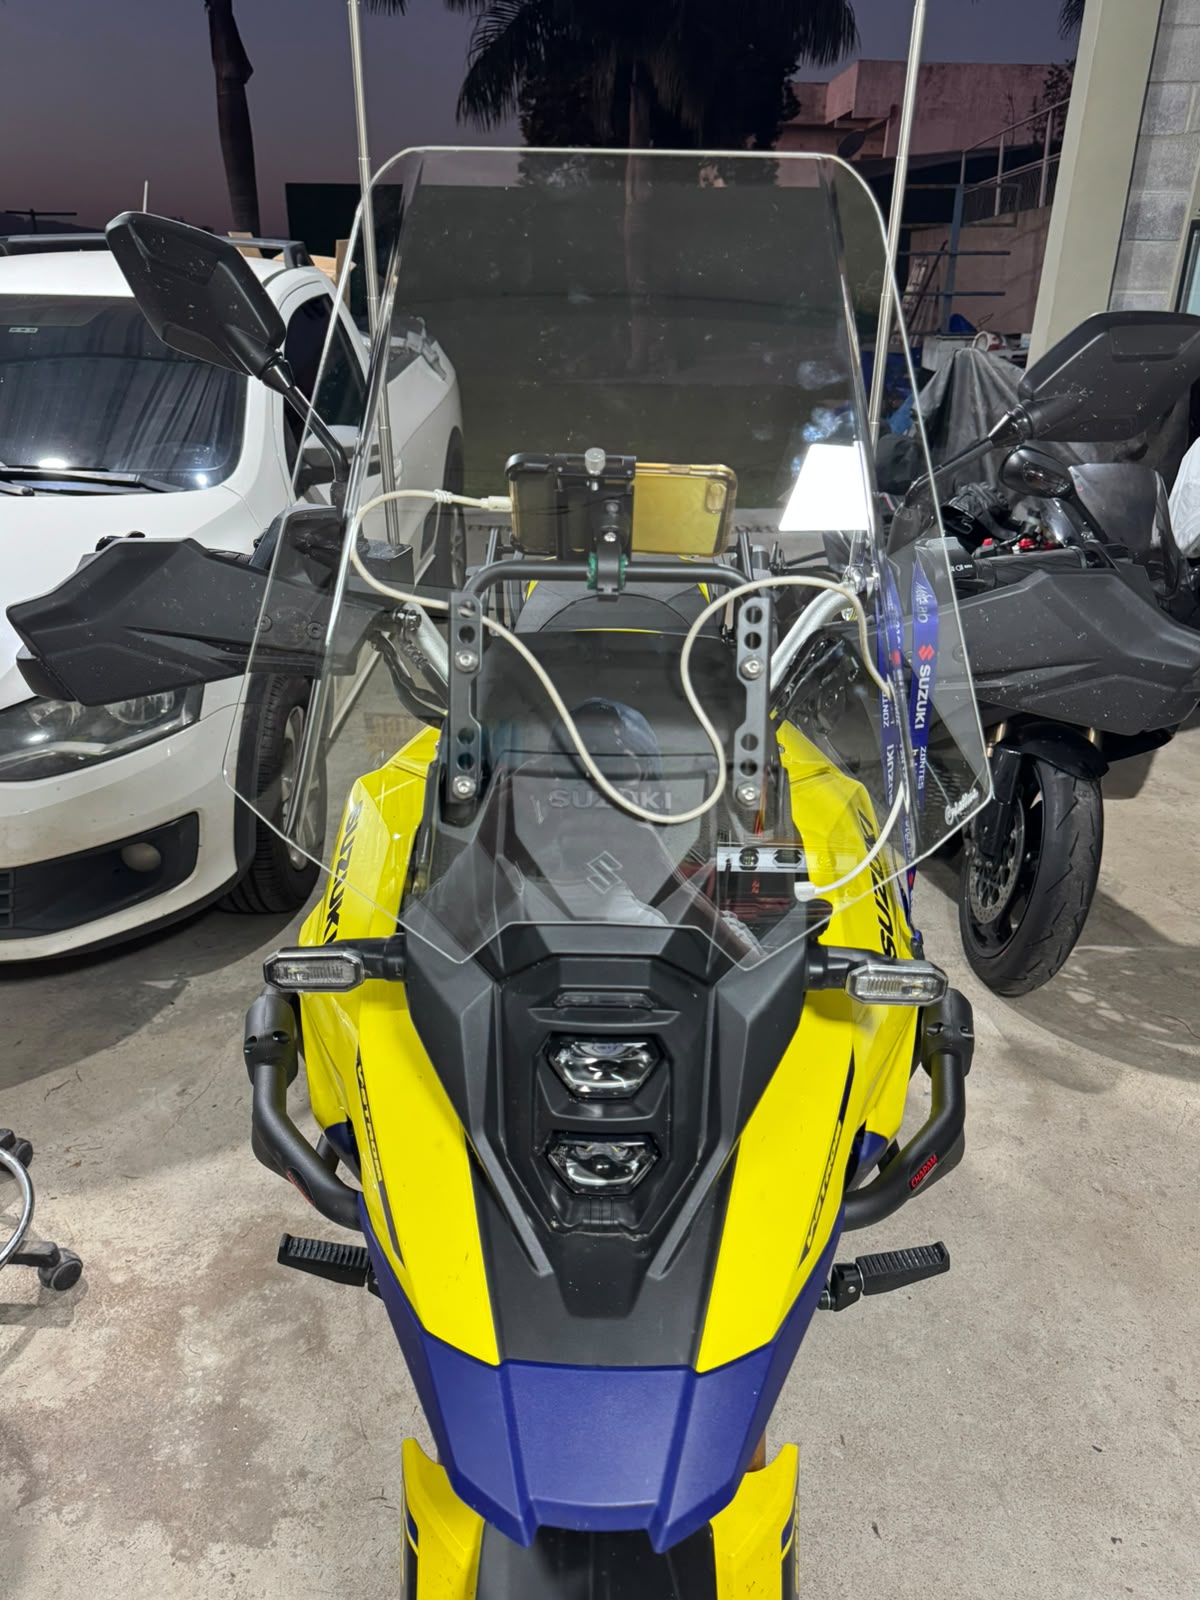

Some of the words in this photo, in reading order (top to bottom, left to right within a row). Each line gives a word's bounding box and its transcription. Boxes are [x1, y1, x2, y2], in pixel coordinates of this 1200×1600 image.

[882, 692, 890, 728] ZONT
[914, 664, 931, 730] SUZUKI
[886, 743, 895, 806] SUZUKI
[917, 745, 927, 790] ZONTES
